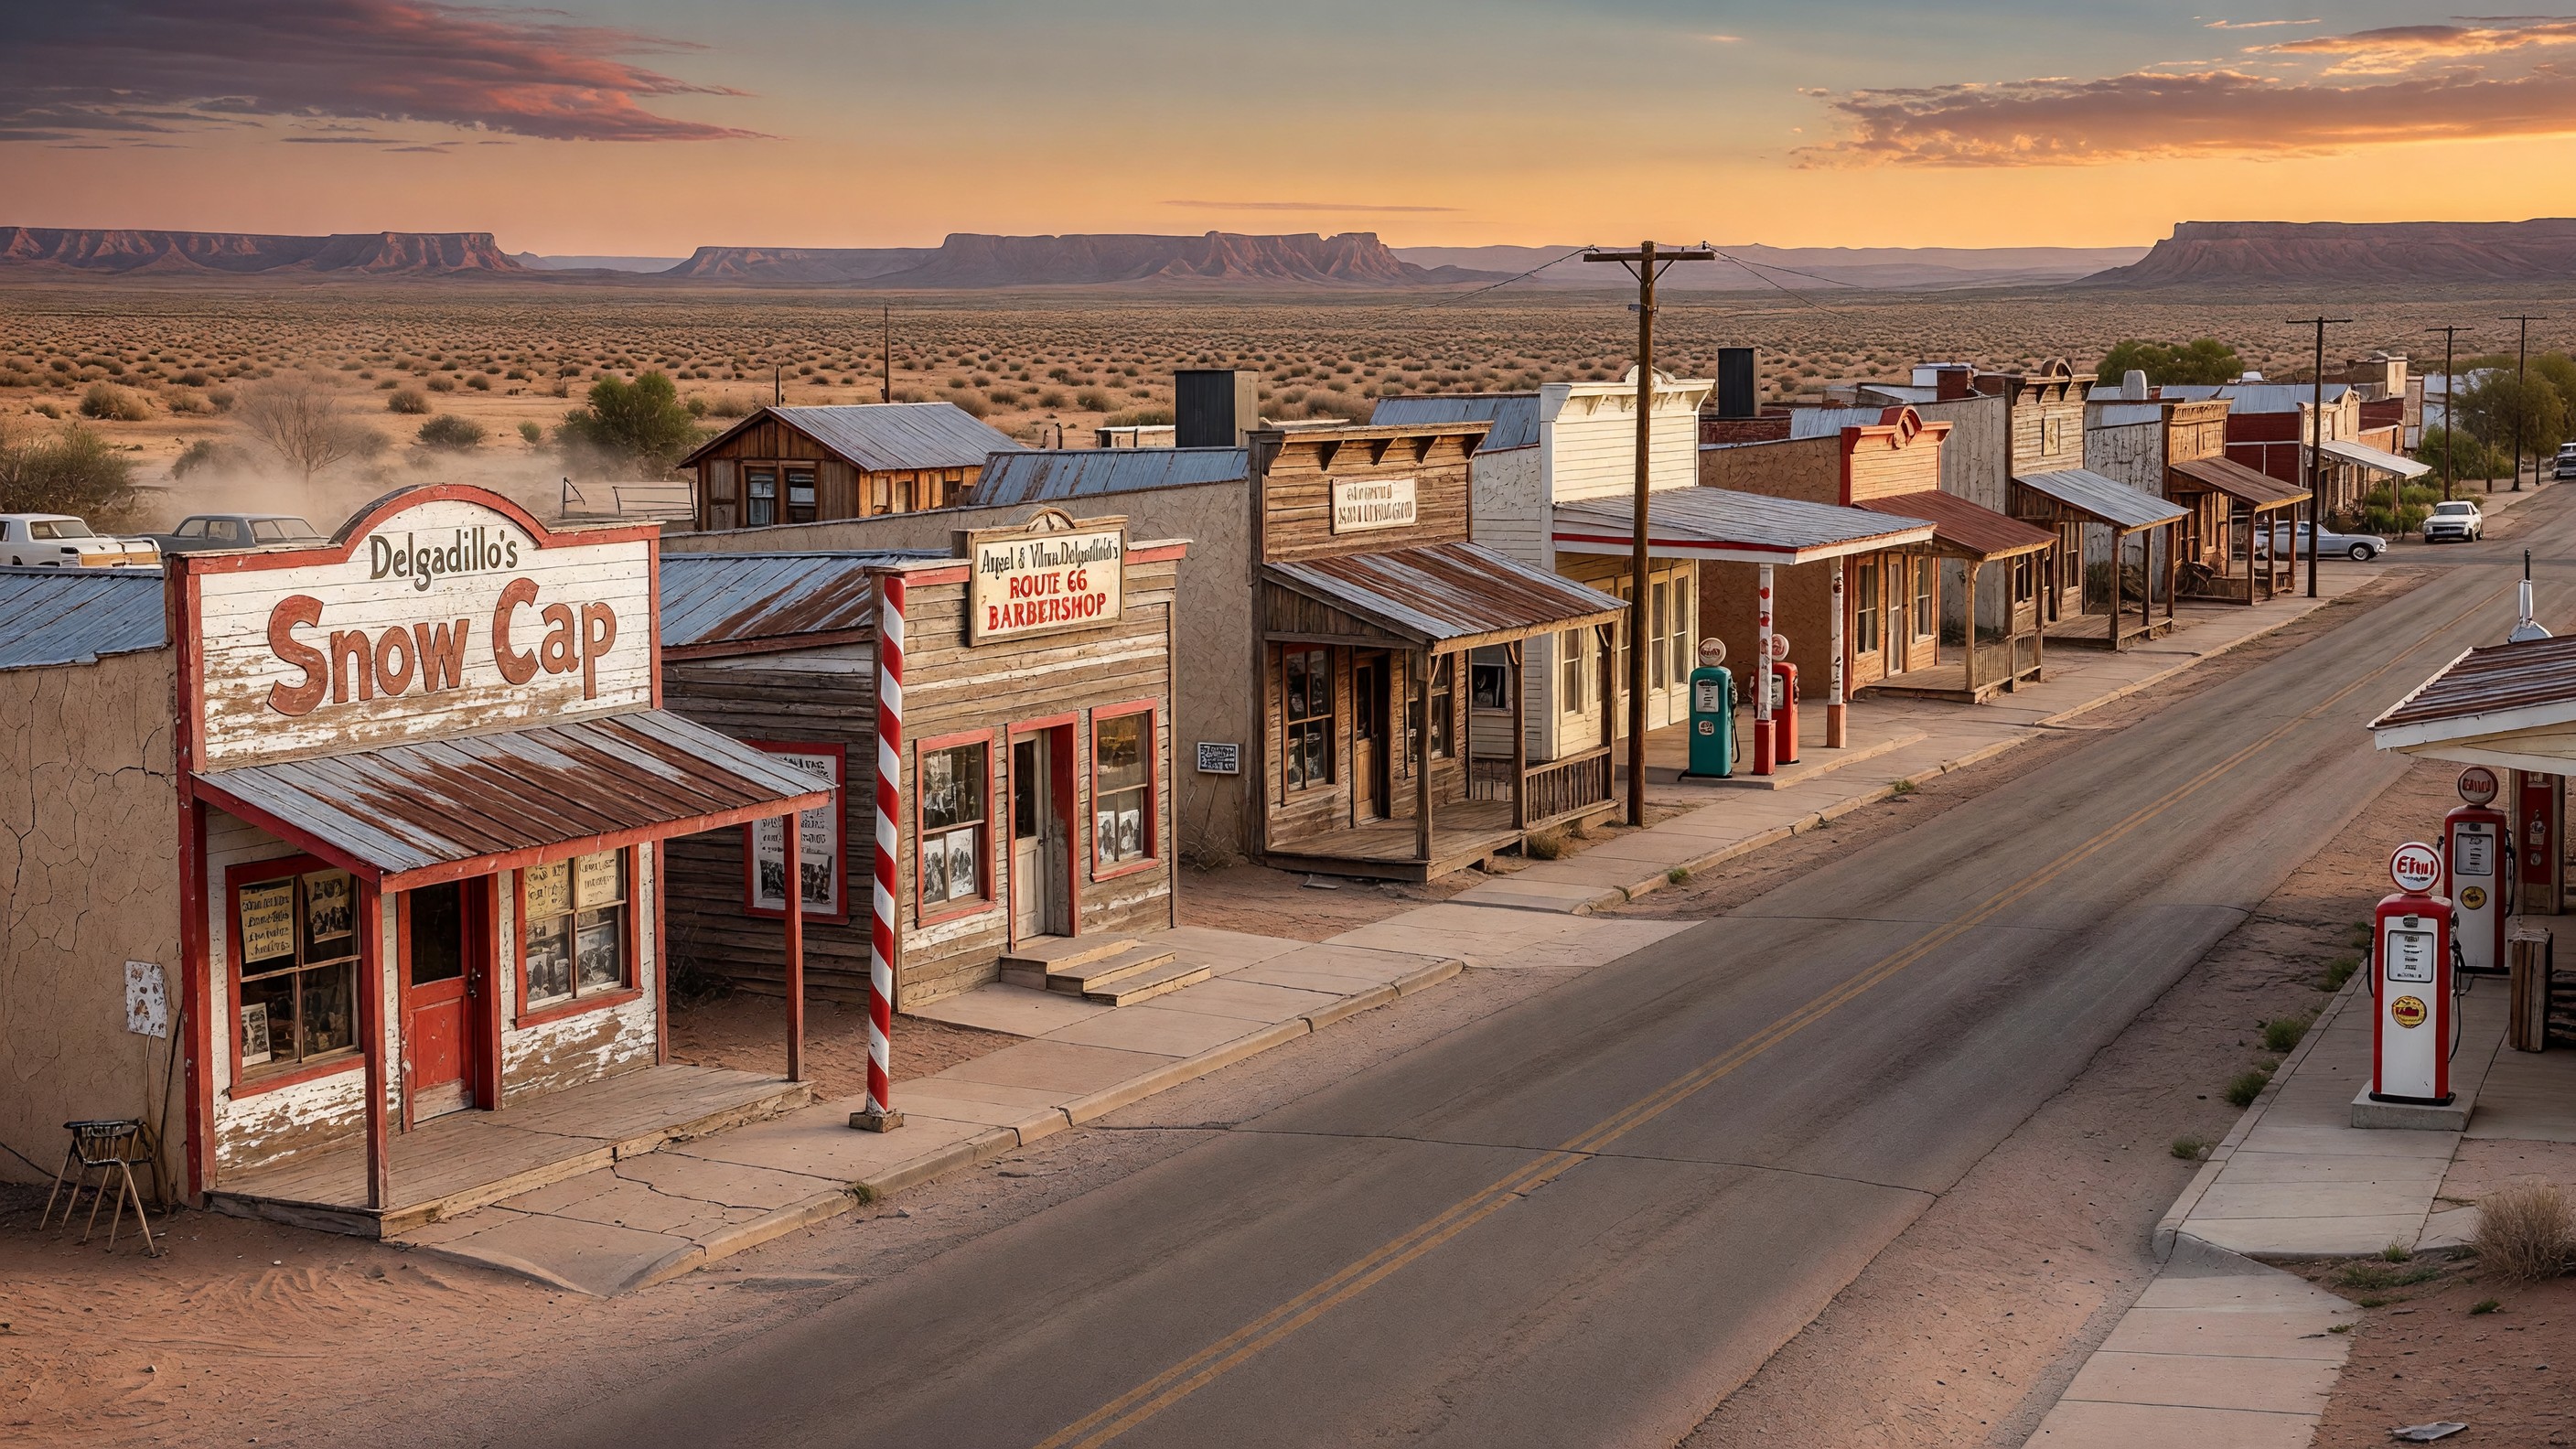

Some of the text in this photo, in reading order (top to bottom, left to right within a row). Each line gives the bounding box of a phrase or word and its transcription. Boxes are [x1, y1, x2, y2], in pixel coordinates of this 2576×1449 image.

[369, 526, 518, 591] Delgadillo's
[1009, 568, 1089, 600] ROUTE 66
[987, 592, 1107, 631] BARBERSHOP
[266, 576, 617, 716] Snow Cap
